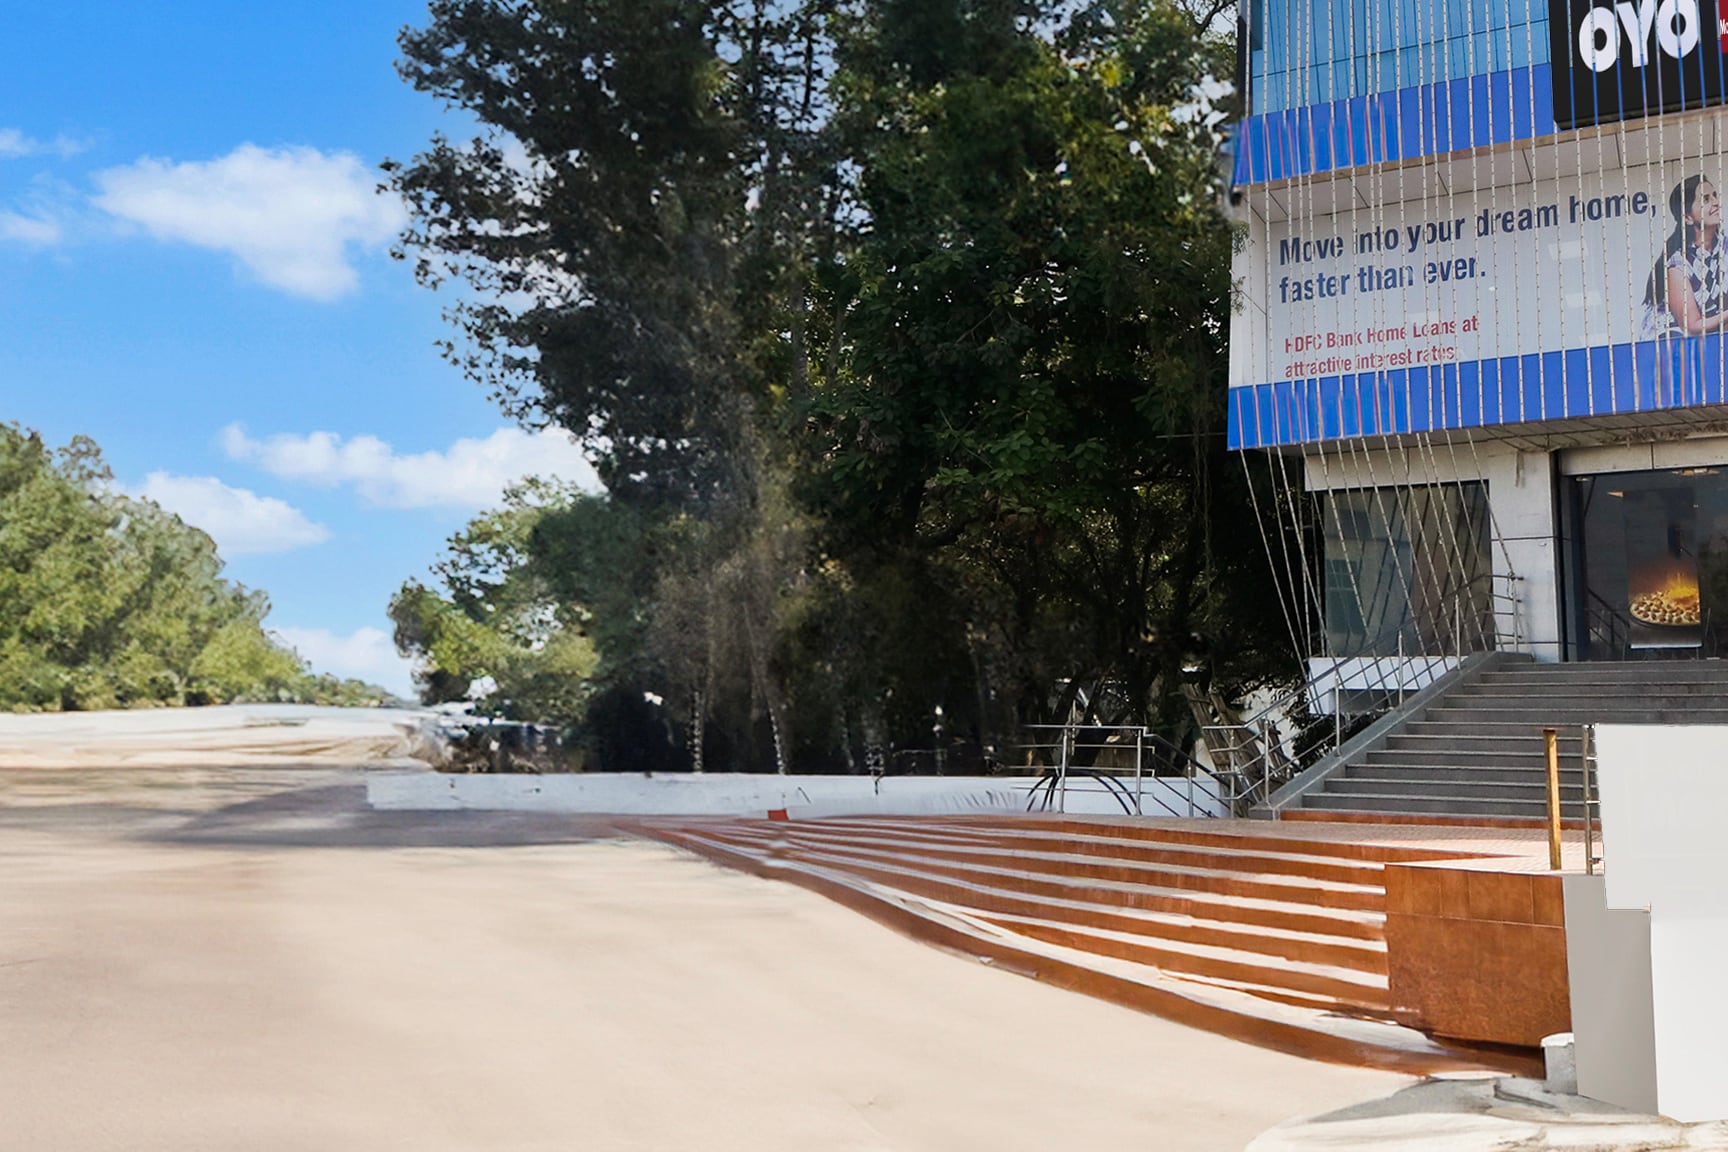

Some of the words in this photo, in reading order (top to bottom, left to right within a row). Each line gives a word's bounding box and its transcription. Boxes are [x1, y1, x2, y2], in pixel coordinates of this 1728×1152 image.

[1279, 235, 1344, 266] Move
[1352, 225, 1399, 255] into
[1407, 217, 1465, 252] your
[1475, 204, 1558, 238] dream
[1569, 191, 1656, 224] home,
[1279, 272, 1350, 304] faster
[1357, 265, 1414, 293] than
[1424, 256, 1486, 284] ever.
[1285, 333, 1322, 353] HDFC
[1326, 330, 1363, 348] Bank
[1367, 326, 1406, 344] Home
[1413, 320, 1456, 339] Loans
[1462, 315, 1479, 333] at
[1285, 356, 1352, 378] attractive
[1355, 348, 1412, 370] interest
[1417, 345, 1455, 363] rates
